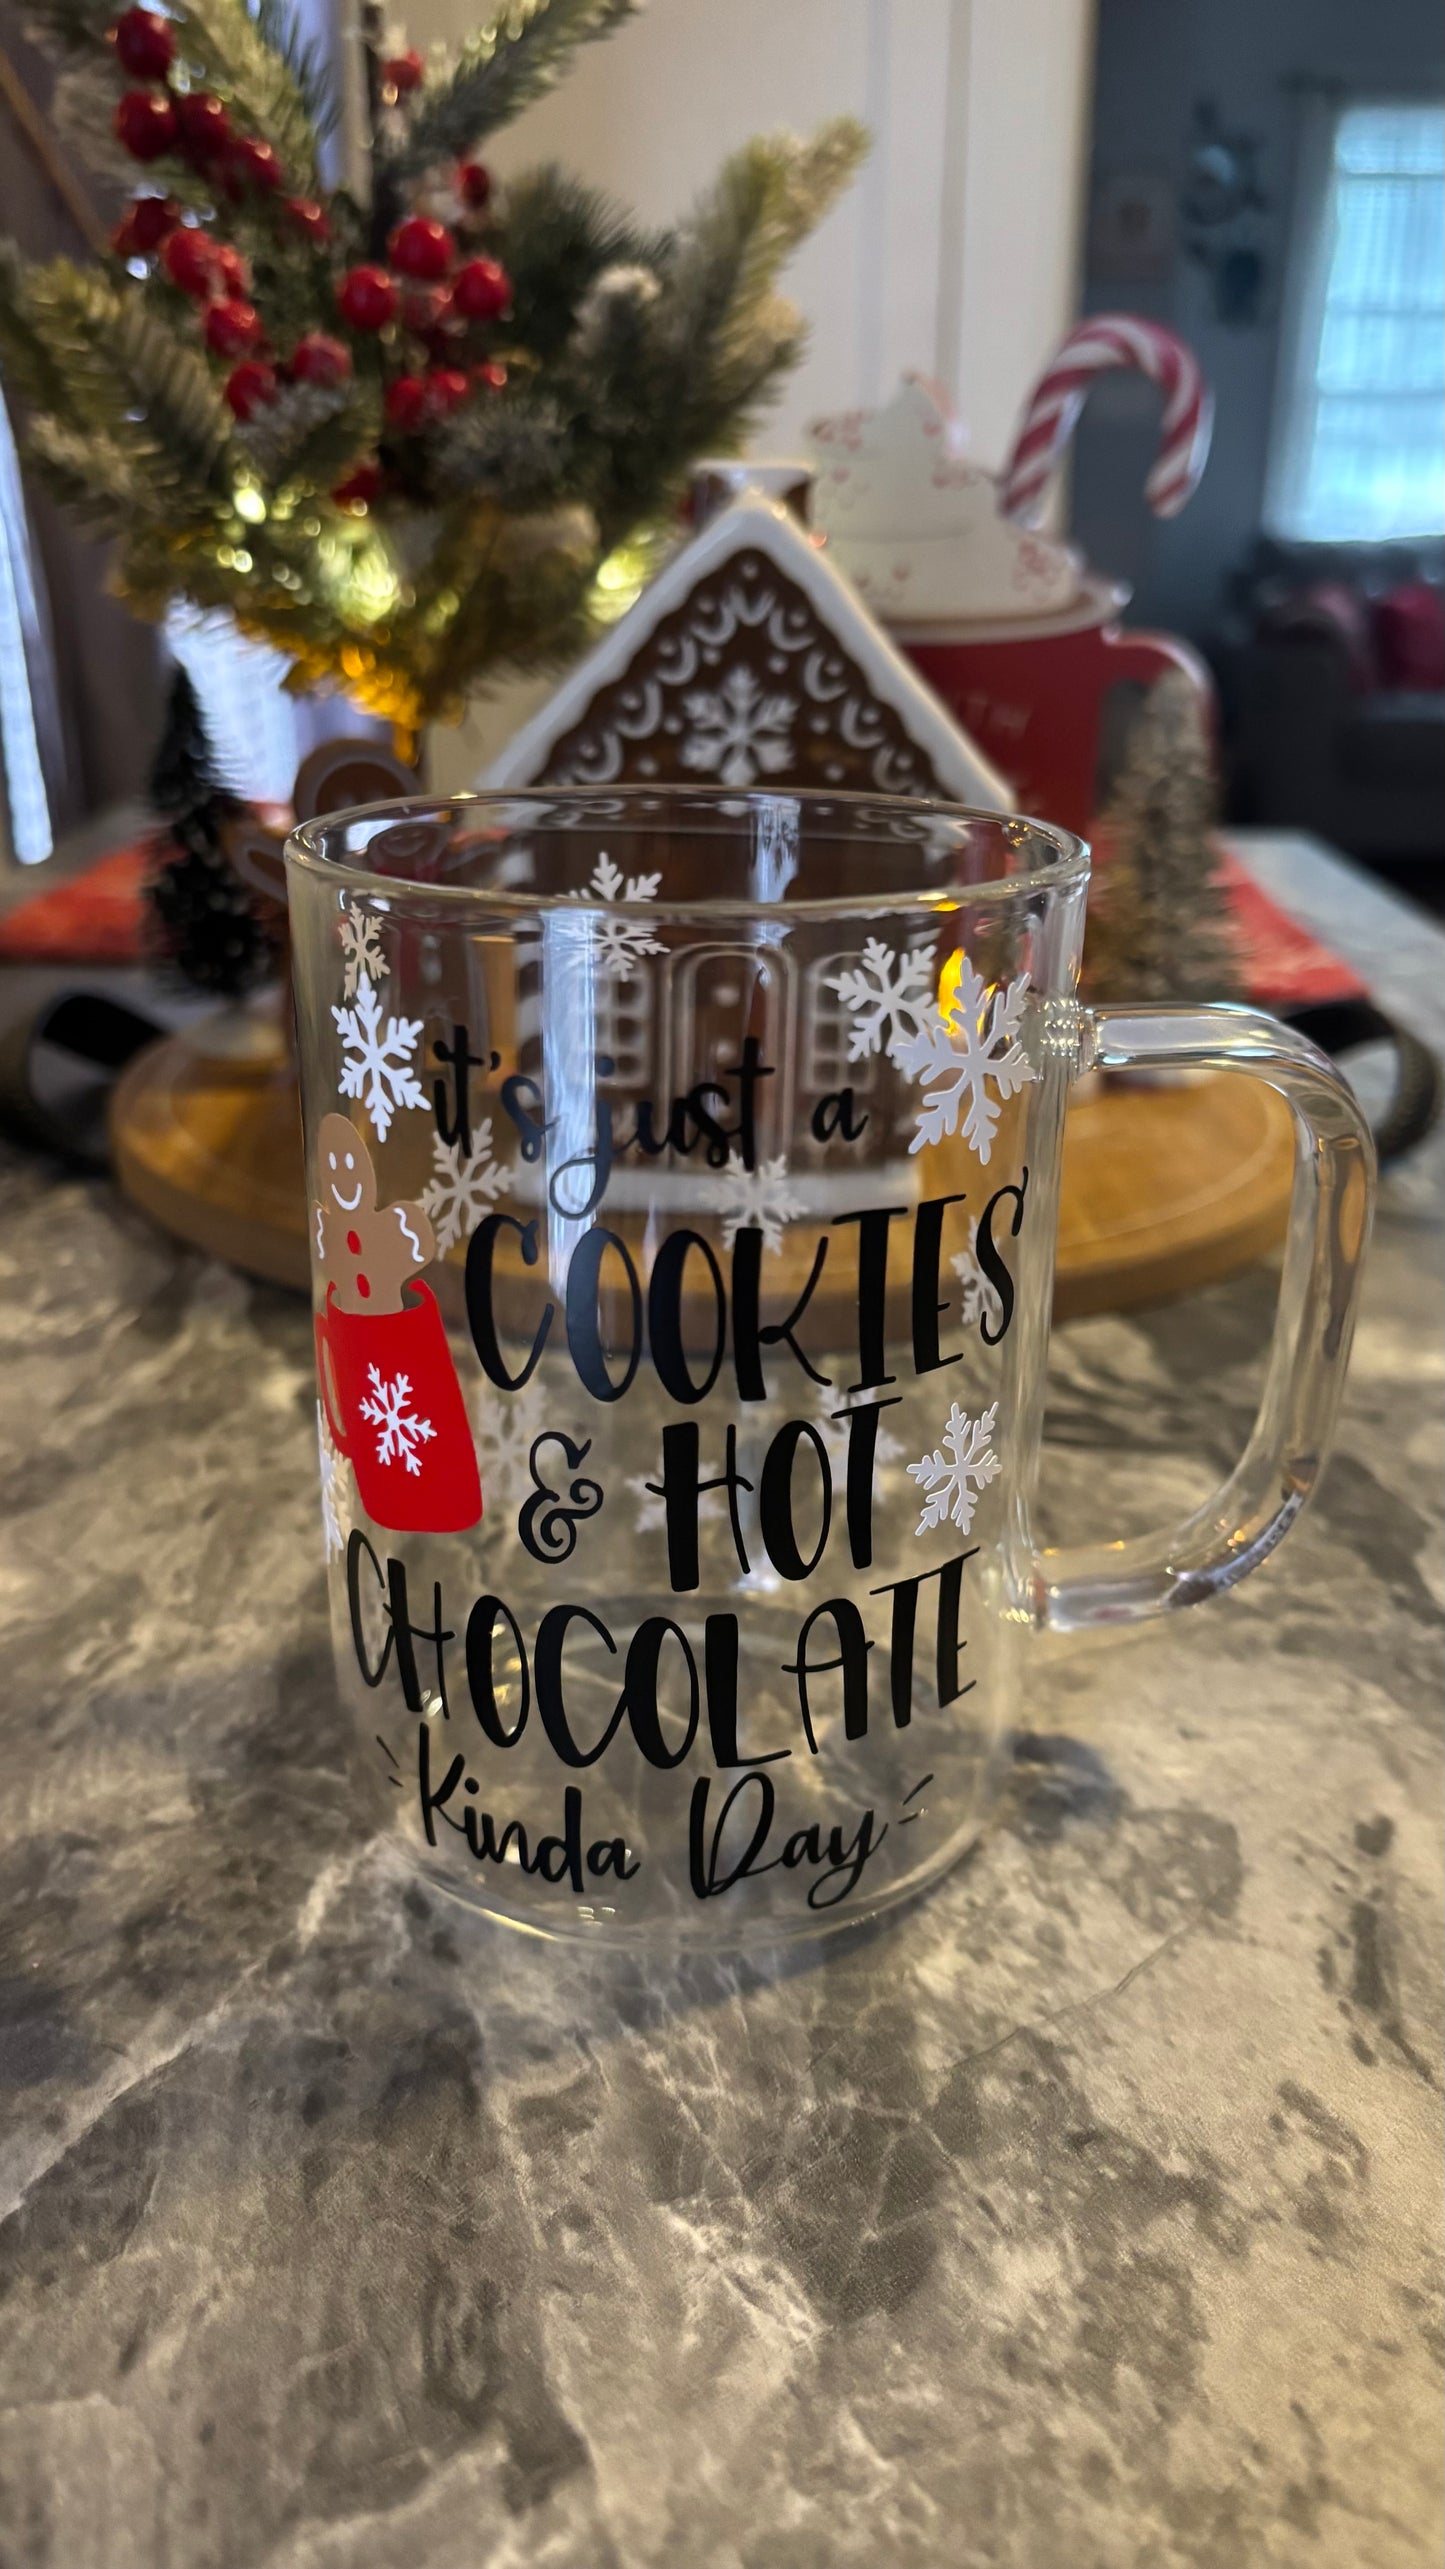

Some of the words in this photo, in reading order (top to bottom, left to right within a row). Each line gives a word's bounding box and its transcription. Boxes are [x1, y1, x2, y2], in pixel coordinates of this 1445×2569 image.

[433, 1025, 555, 1163] it's
[550, 1037, 775, 1219] just
[811, 1088, 869, 1143] a
[465, 1166, 1028, 1404] COOKIES
[519, 1432, 604, 1564] &
[645, 1397, 903, 1592] HOT
[347, 1529, 980, 1769] CHOCOLATE
[419, 1722, 641, 1893] Kinda
[689, 1772, 888, 1909] Day
